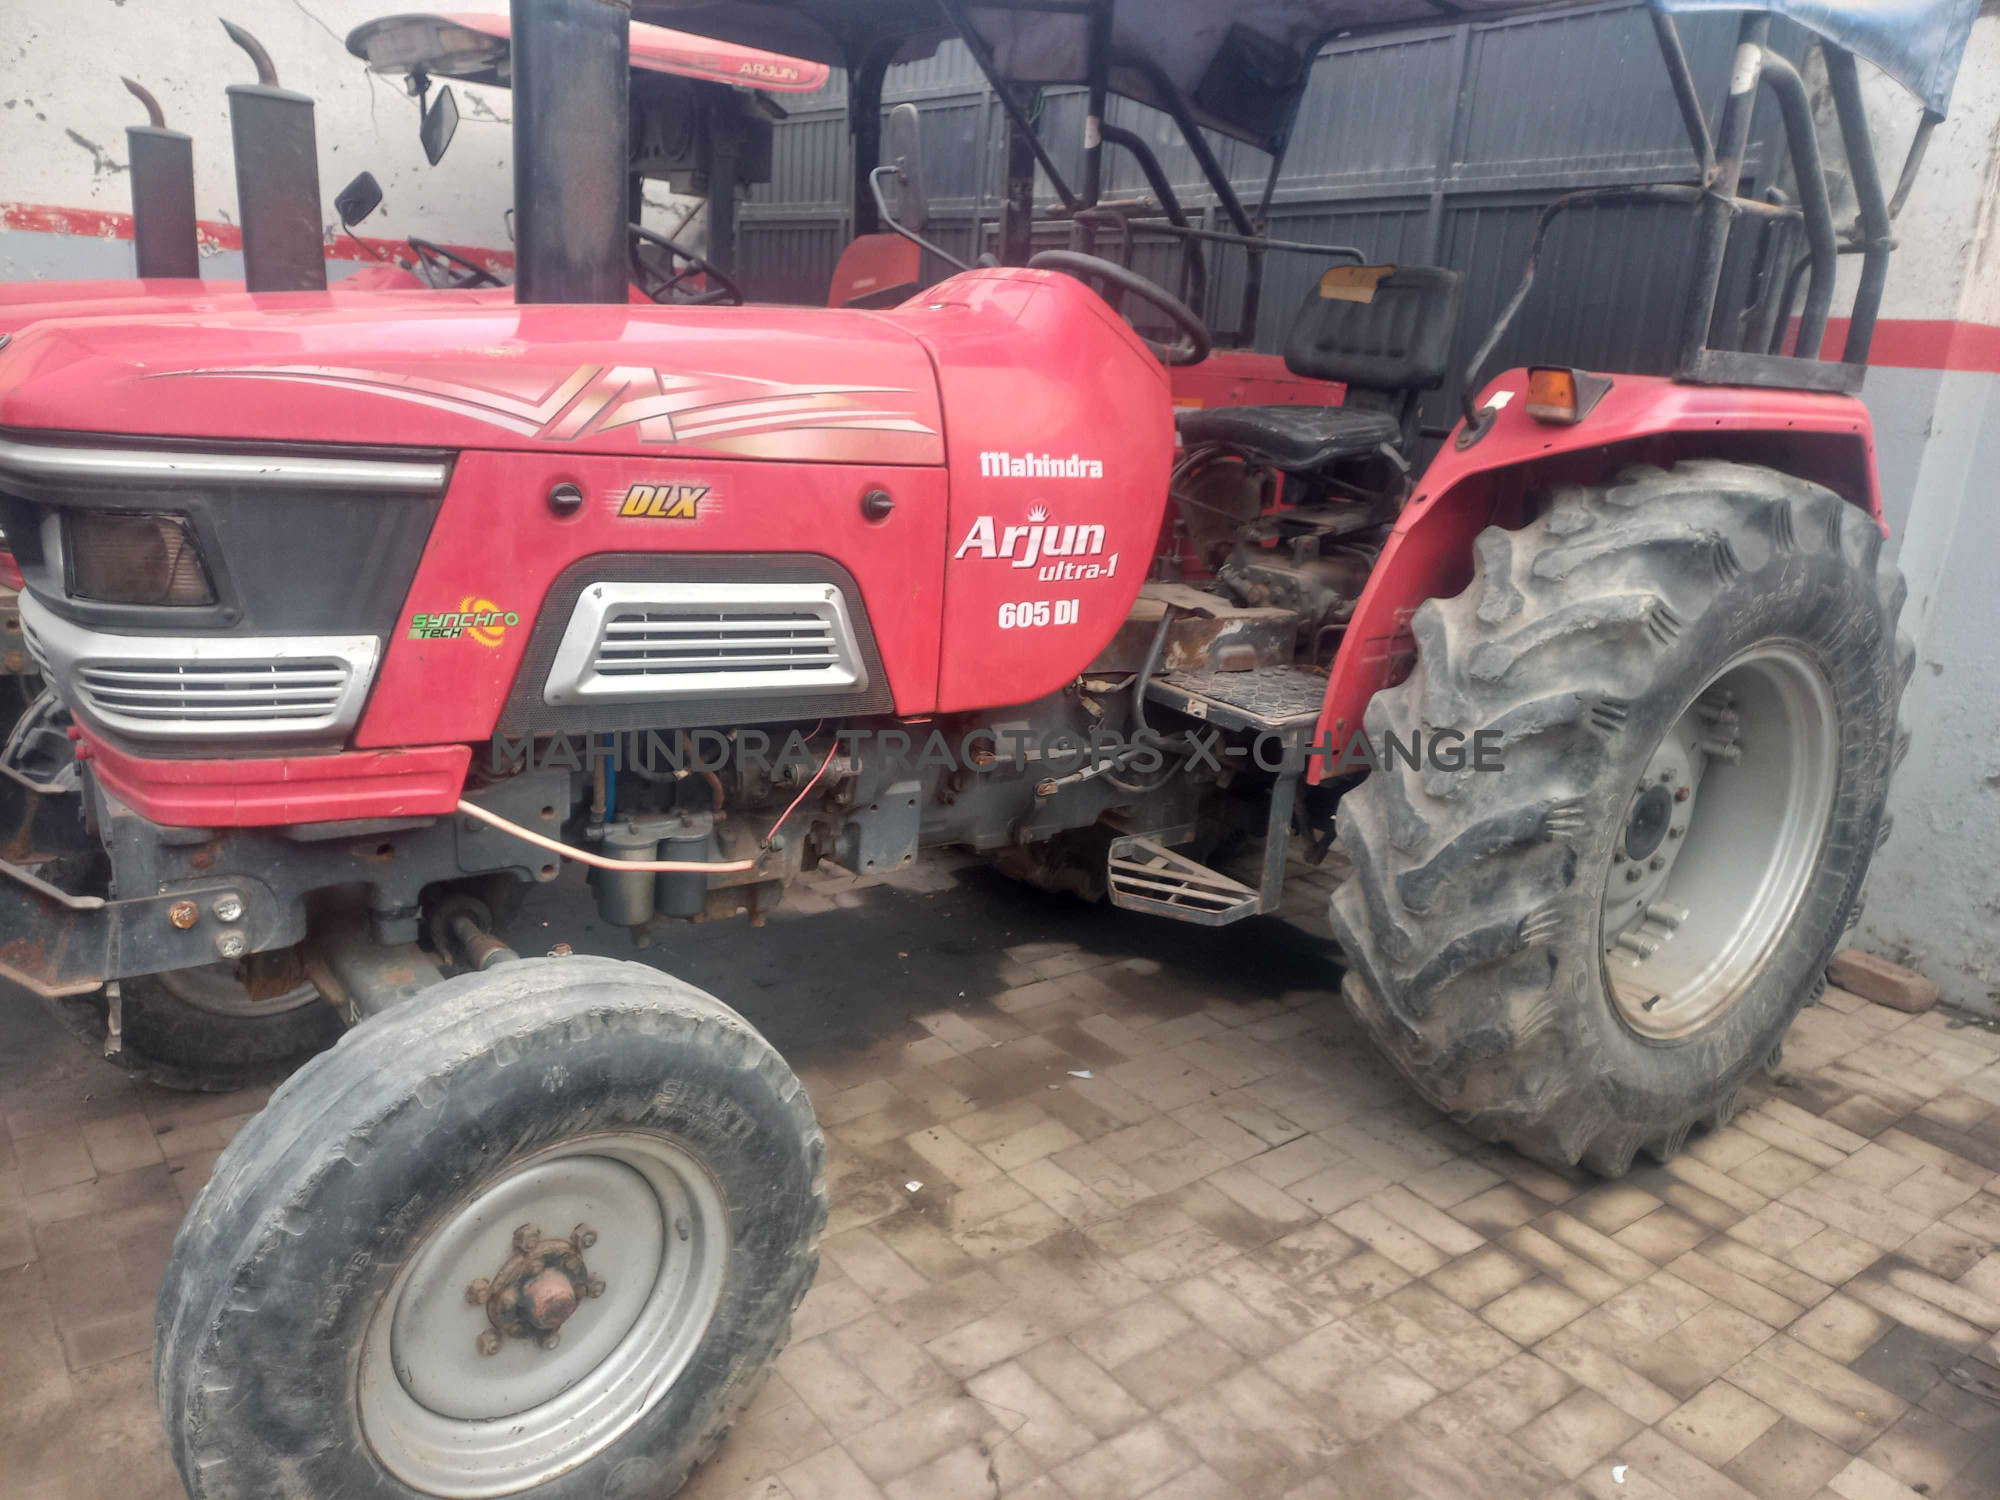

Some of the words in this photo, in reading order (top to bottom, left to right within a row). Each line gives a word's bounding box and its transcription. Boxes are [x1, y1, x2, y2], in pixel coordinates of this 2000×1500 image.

[739, 62, 798, 79] ARJUN
[980, 452, 1103, 478] Mahindra
[617, 484, 710, 519] DLX
[953, 515, 1106, 568] Arjun
[1038, 552, 1119, 582] ultra-1
[998, 600, 1050, 629] 605
[1053, 599, 1080, 625] DI
